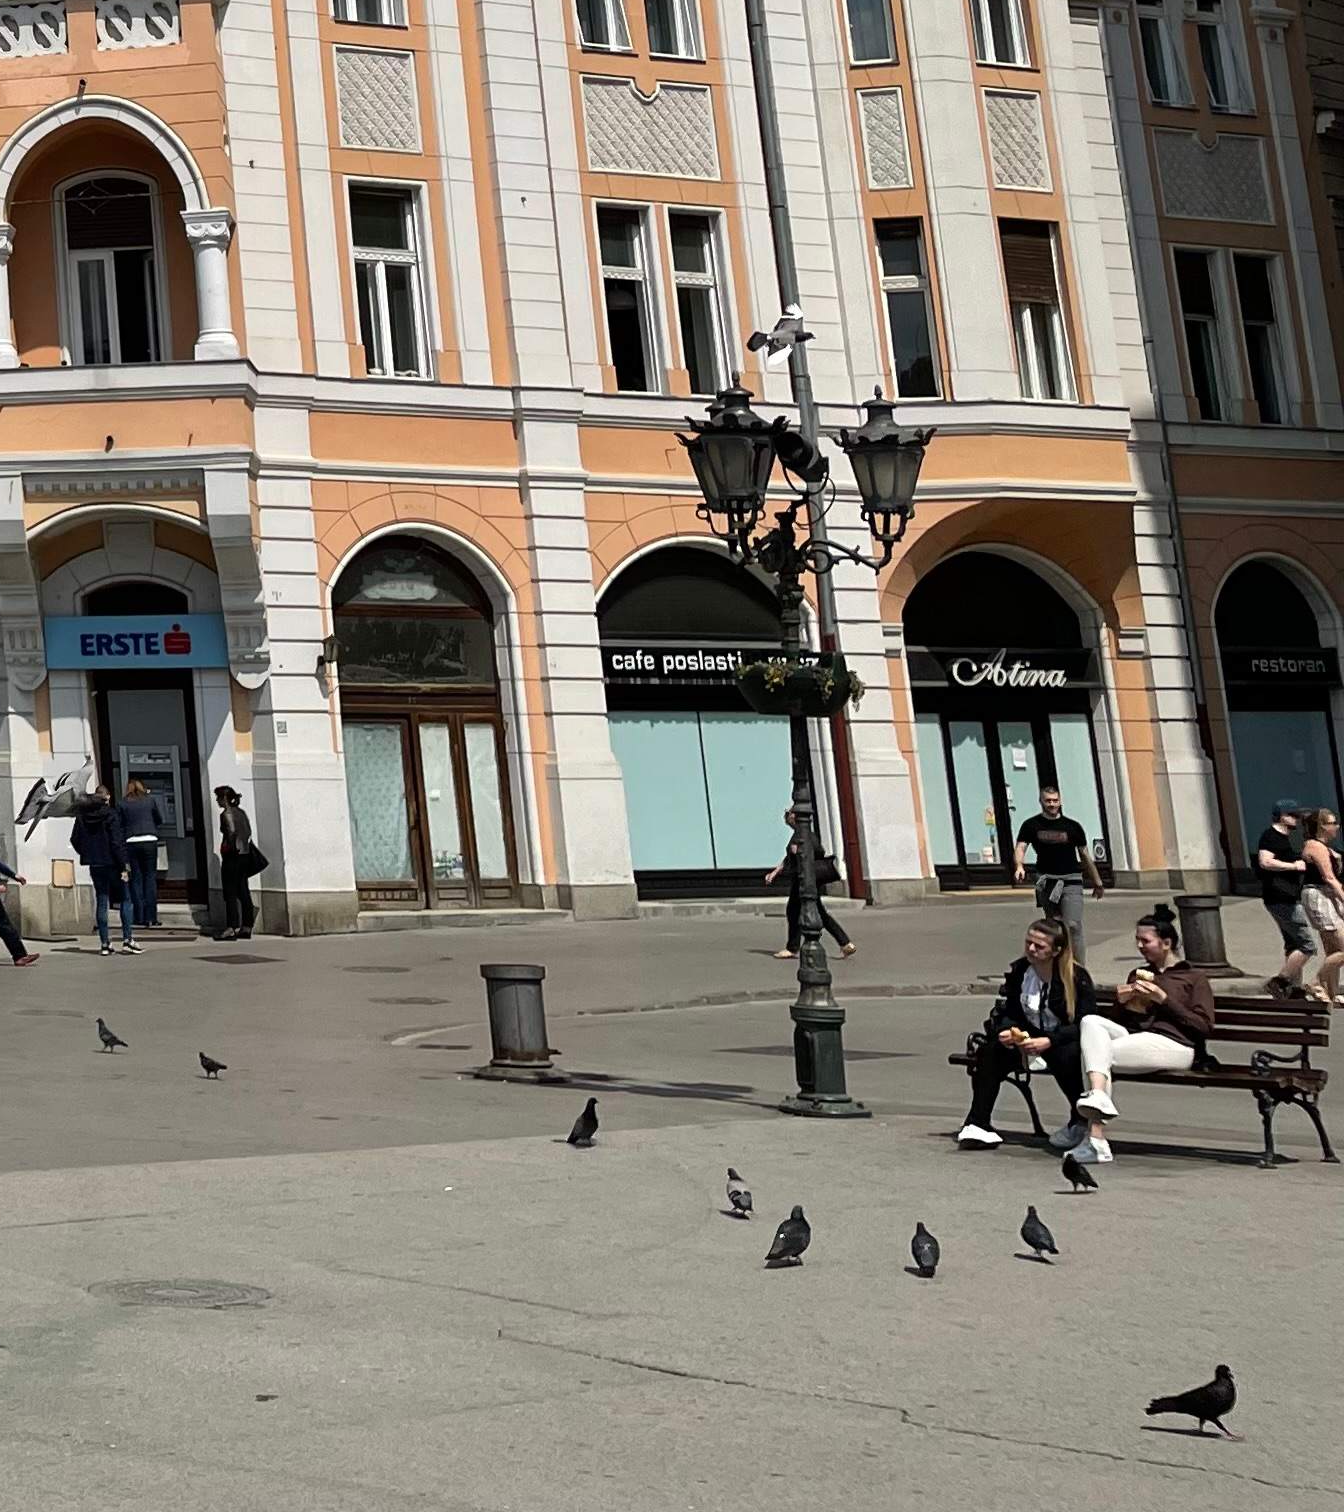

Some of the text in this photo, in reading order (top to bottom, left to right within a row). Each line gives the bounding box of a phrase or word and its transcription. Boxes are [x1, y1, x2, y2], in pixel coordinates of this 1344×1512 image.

[80, 633, 160, 656] ERSTE
[612, 650, 655, 670] cafe
[953, 648, 1067, 687] Atina
[1252, 657, 1326, 672] restoran
